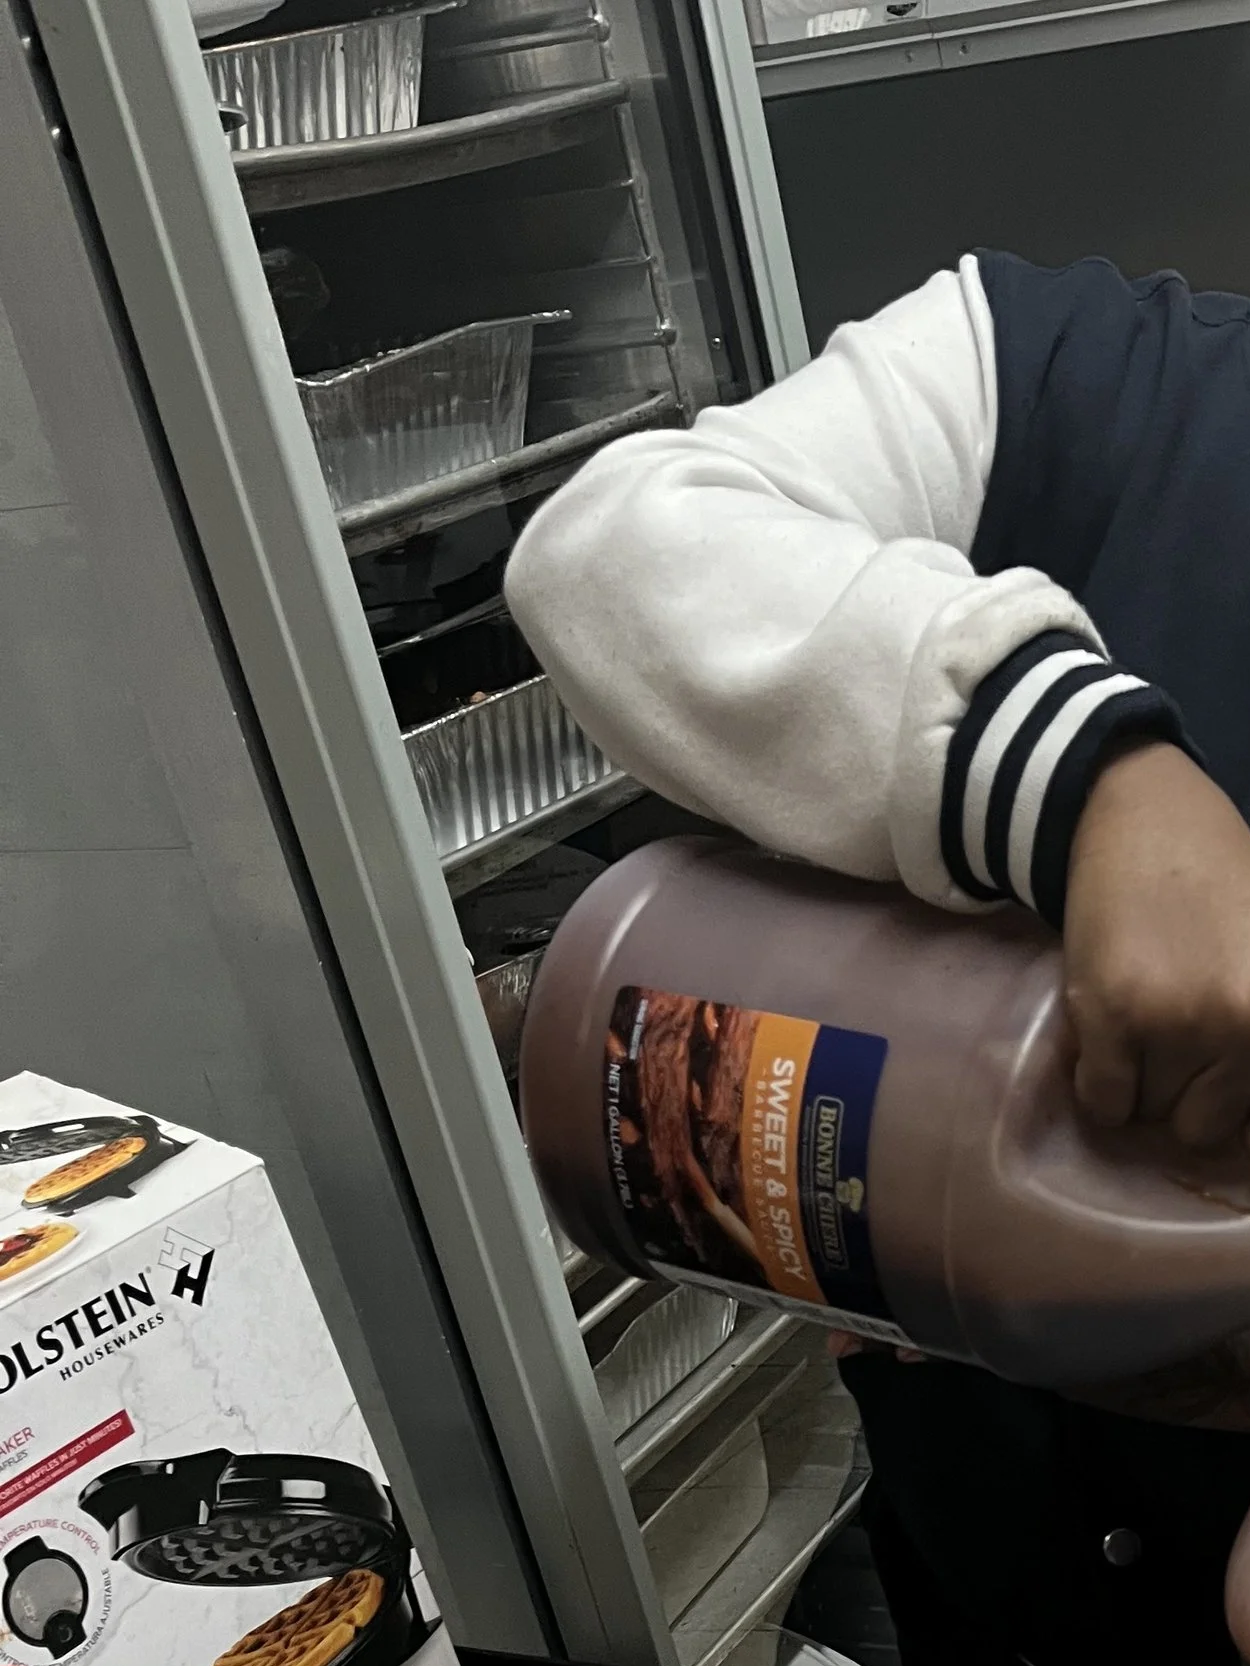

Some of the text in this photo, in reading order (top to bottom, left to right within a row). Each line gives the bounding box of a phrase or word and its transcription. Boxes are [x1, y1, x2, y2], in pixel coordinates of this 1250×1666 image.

[608, 1063, 621, 1096] NET
[608, 1105, 624, 1166] GALLON
[815, 1106, 838, 1189] BONNE
[764, 1057, 806, 1281] SWEET & SPICY
[60, 1312, 165, 1381] HOUSEWARES
[24, 1458, 60, 1484] WAFFLES
[61, 1521, 101, 1556] CONTROL
[101, 1567, 112, 1626] AJUSTABLE
